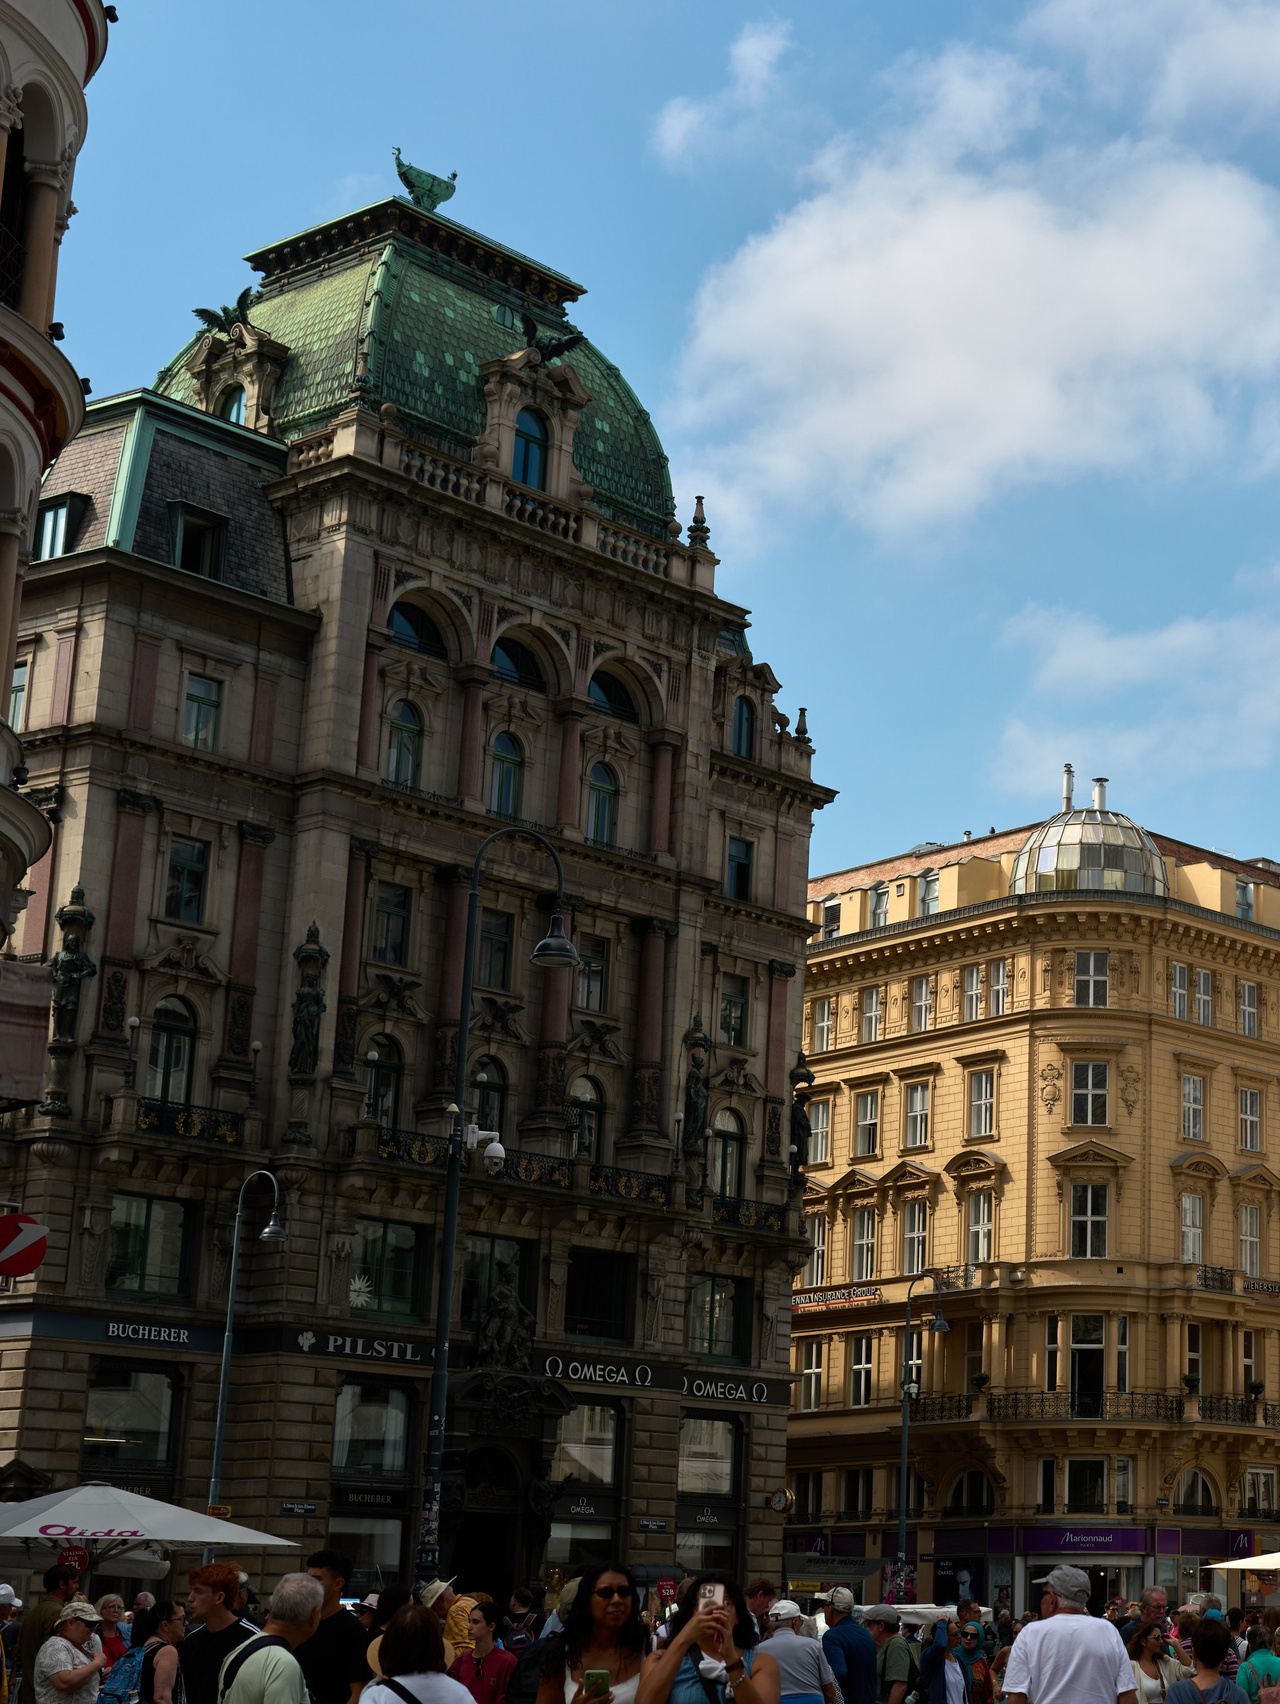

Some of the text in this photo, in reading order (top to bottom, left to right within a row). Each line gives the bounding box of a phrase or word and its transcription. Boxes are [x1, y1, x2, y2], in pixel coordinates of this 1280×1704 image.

[791, 1286, 876, 1305] ENNA INSURANCE GROUP
[108, 1322, 189, 1343] BUCHERER
[326, 1335, 421, 1361] PILSTL
[568, 1362, 629, 1384] OMEGA
[692, 1380, 747, 1400] OMEGA
[348, 1493, 392, 1504] BUCHERER
[570, 1505, 595, 1514] OMEGA
[696, 1515, 718, 1523] OMEGA
[1060, 1531, 1113, 1545] Marionnaud
[806, 1557, 866, 1566] WIENER WÜRSTL
